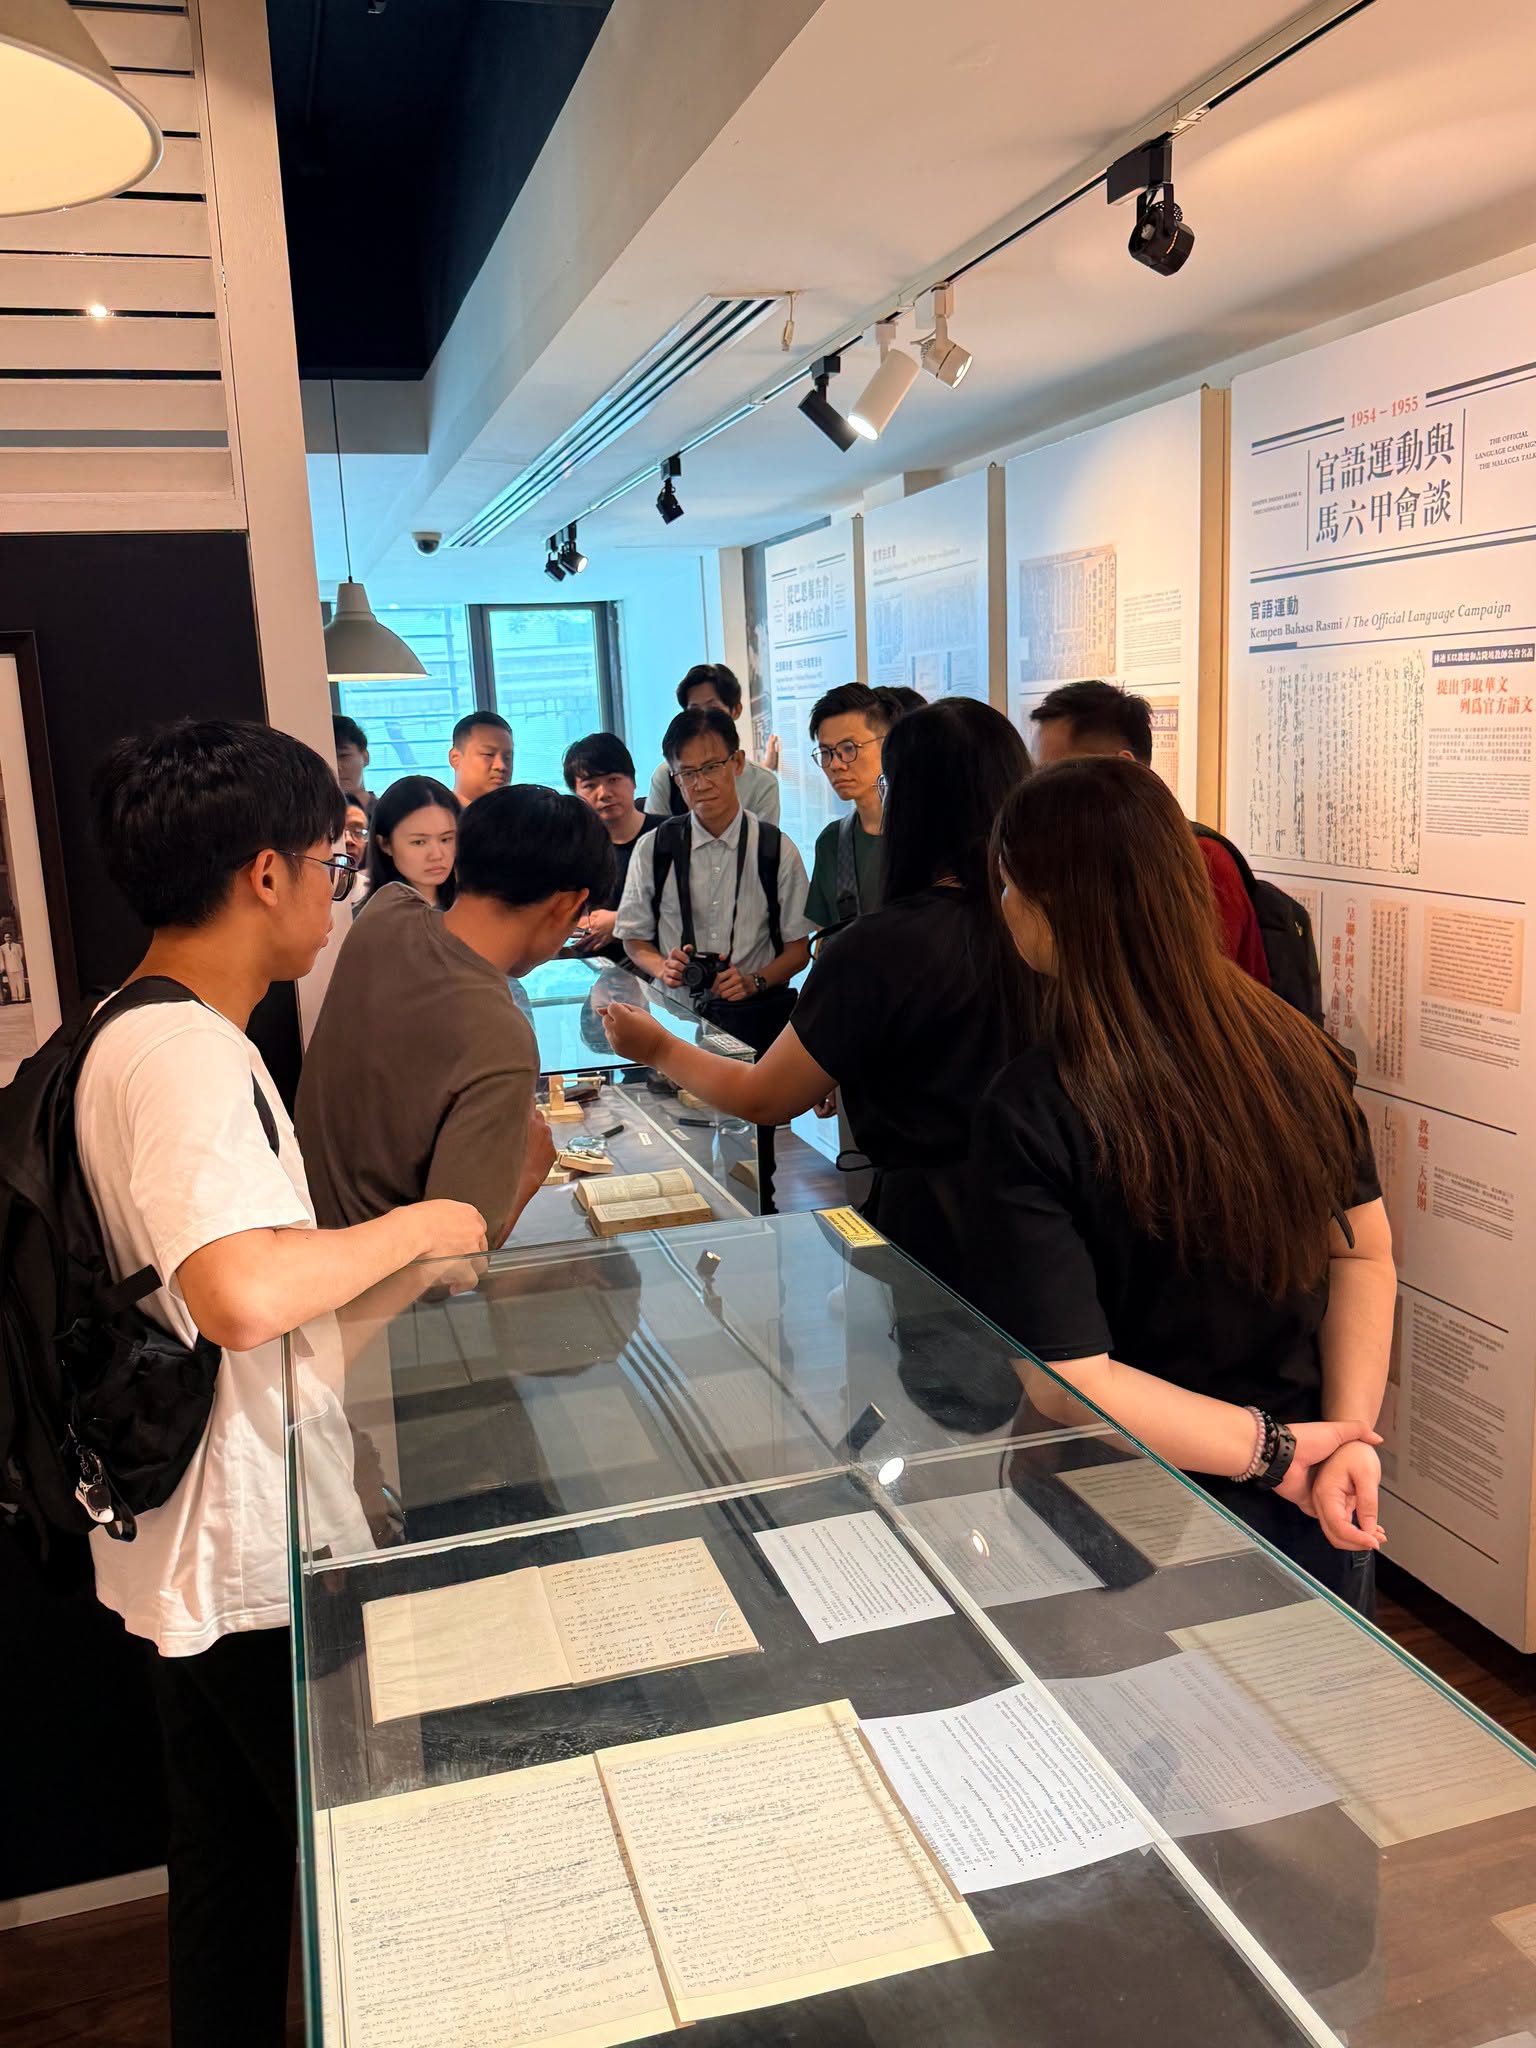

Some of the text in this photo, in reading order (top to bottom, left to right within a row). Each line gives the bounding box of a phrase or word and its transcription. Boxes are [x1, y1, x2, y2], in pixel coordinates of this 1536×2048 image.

[1351, 409, 1377, 429] 1954
[1391, 395, 1419, 418] 1955
[1489, 430, 1529, 446] THE OFFICIAL
[1316, 422, 1455, 495] 官語運動與
[1475, 447, 1506, 460] LANGUAGE
[1479, 462, 1491, 471] THE
[1315, 478, 1452, 543] 馬六甲會談
[1249, 595, 1299, 620] 官語運動
[1250, 627, 1283, 641] Kempen
[1285, 622, 1314, 635] Bahasa
[1316, 618, 1342, 632] Rasmi
[1352, 614, 1370, 629] The
[1371, 611, 1405, 631] Official
[1408, 608, 1455, 626] Language
[1457, 601, 1512, 621] Campaign
